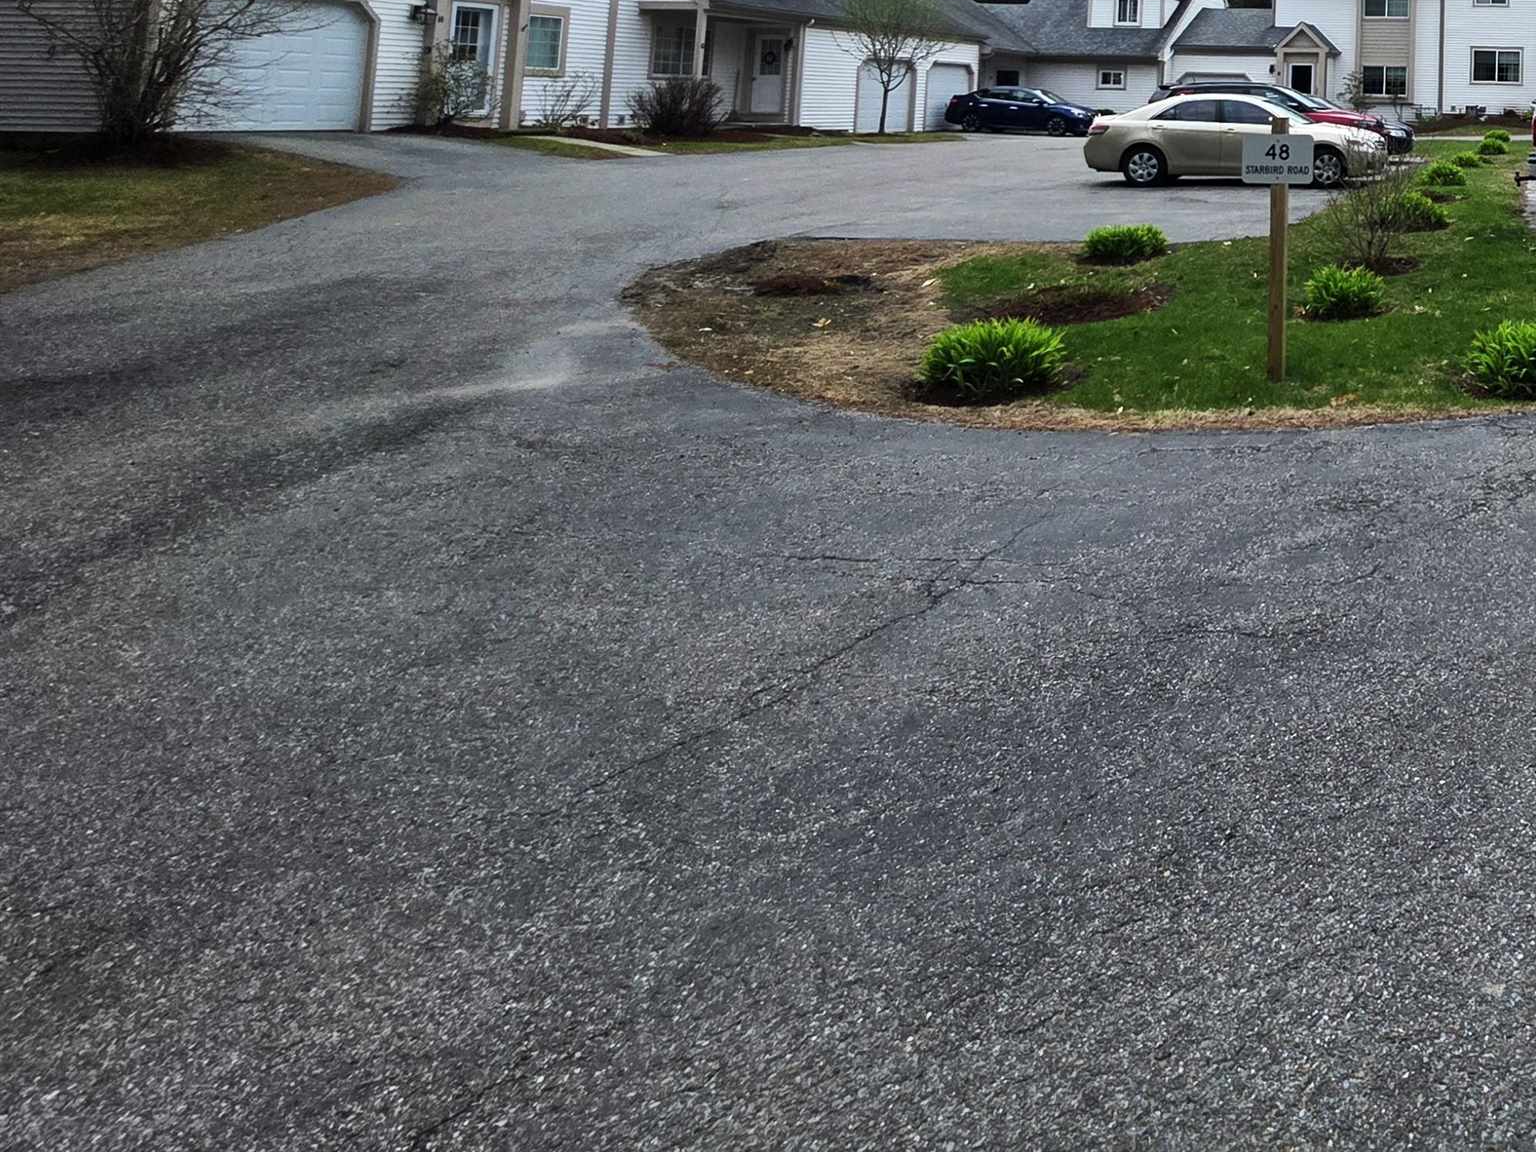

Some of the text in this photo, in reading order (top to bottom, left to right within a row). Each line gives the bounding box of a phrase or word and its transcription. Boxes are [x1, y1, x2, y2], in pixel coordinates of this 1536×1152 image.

[1265, 143, 1290, 160] 48
[1246, 165, 1310, 175] STARBIRD ROAD
